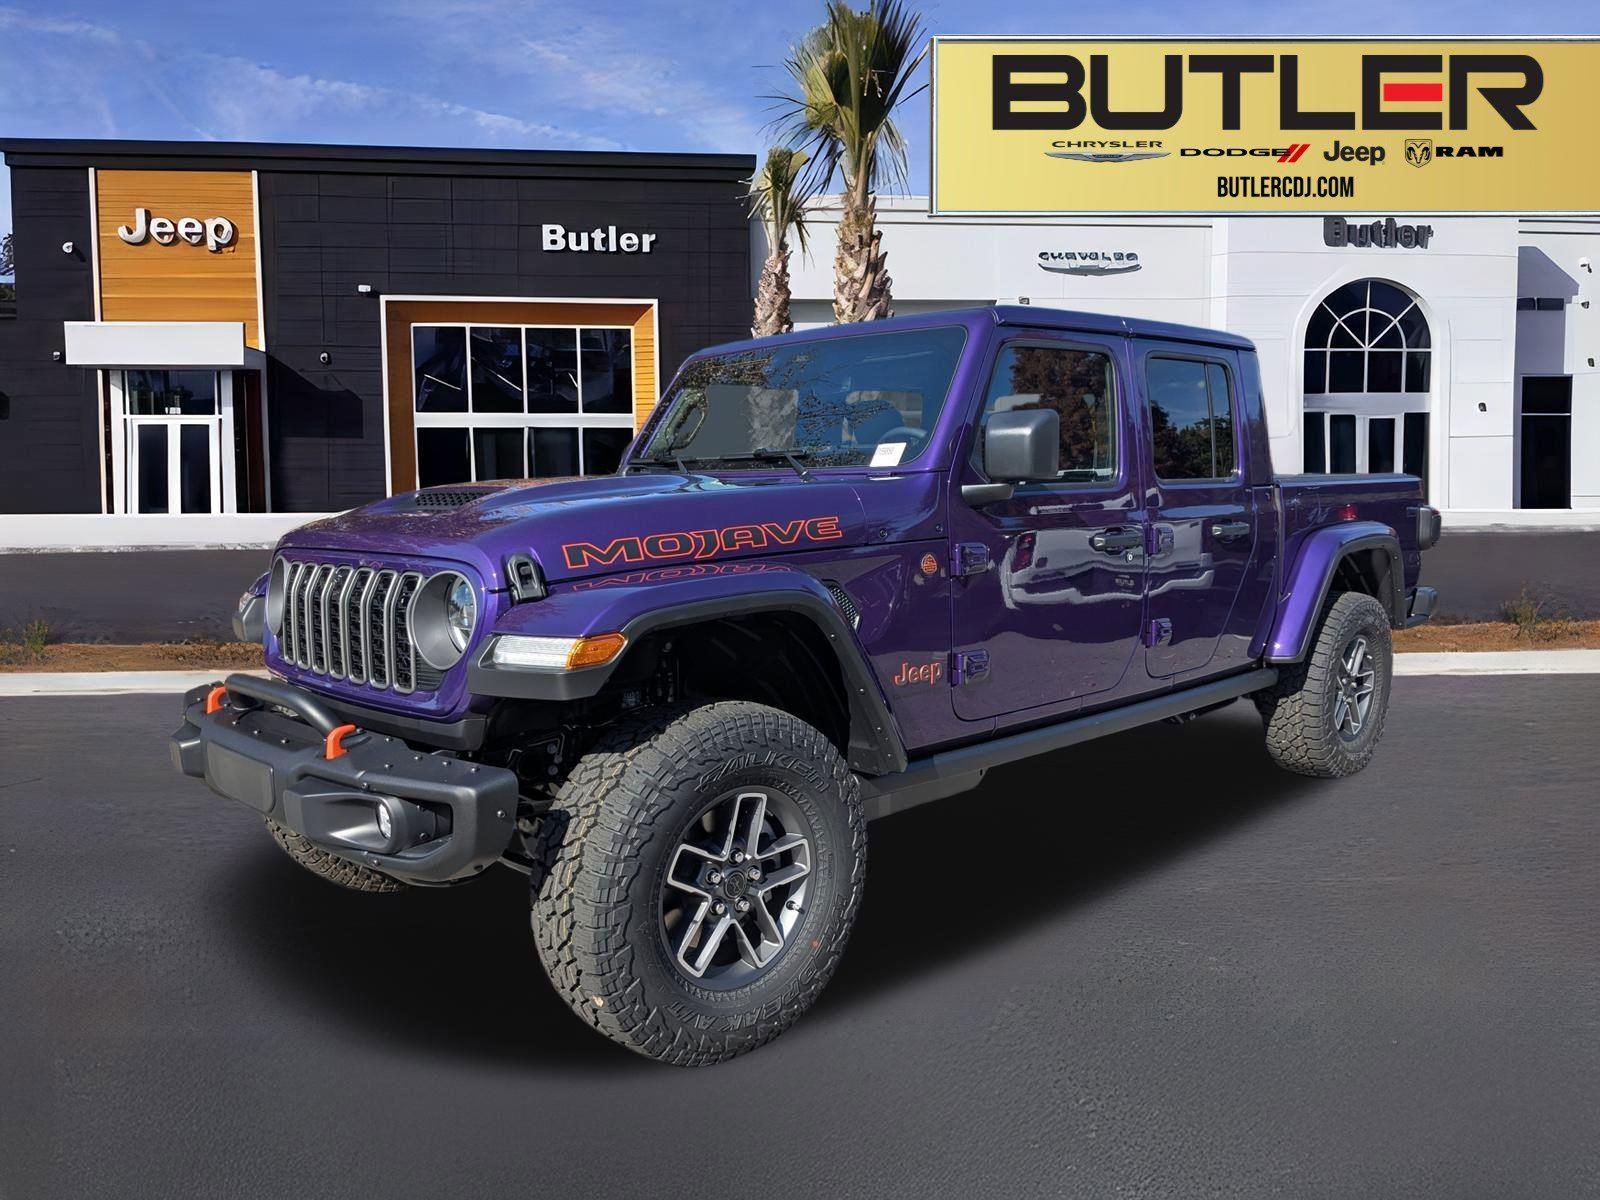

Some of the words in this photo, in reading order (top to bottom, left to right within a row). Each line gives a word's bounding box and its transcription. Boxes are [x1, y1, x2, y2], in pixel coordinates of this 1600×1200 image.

[117, 207, 234, 251] Jeep
[541, 224, 656, 252] Butler
[562, 516, 842, 569] MOJAVE
[894, 662, 942, 687] Jeep
